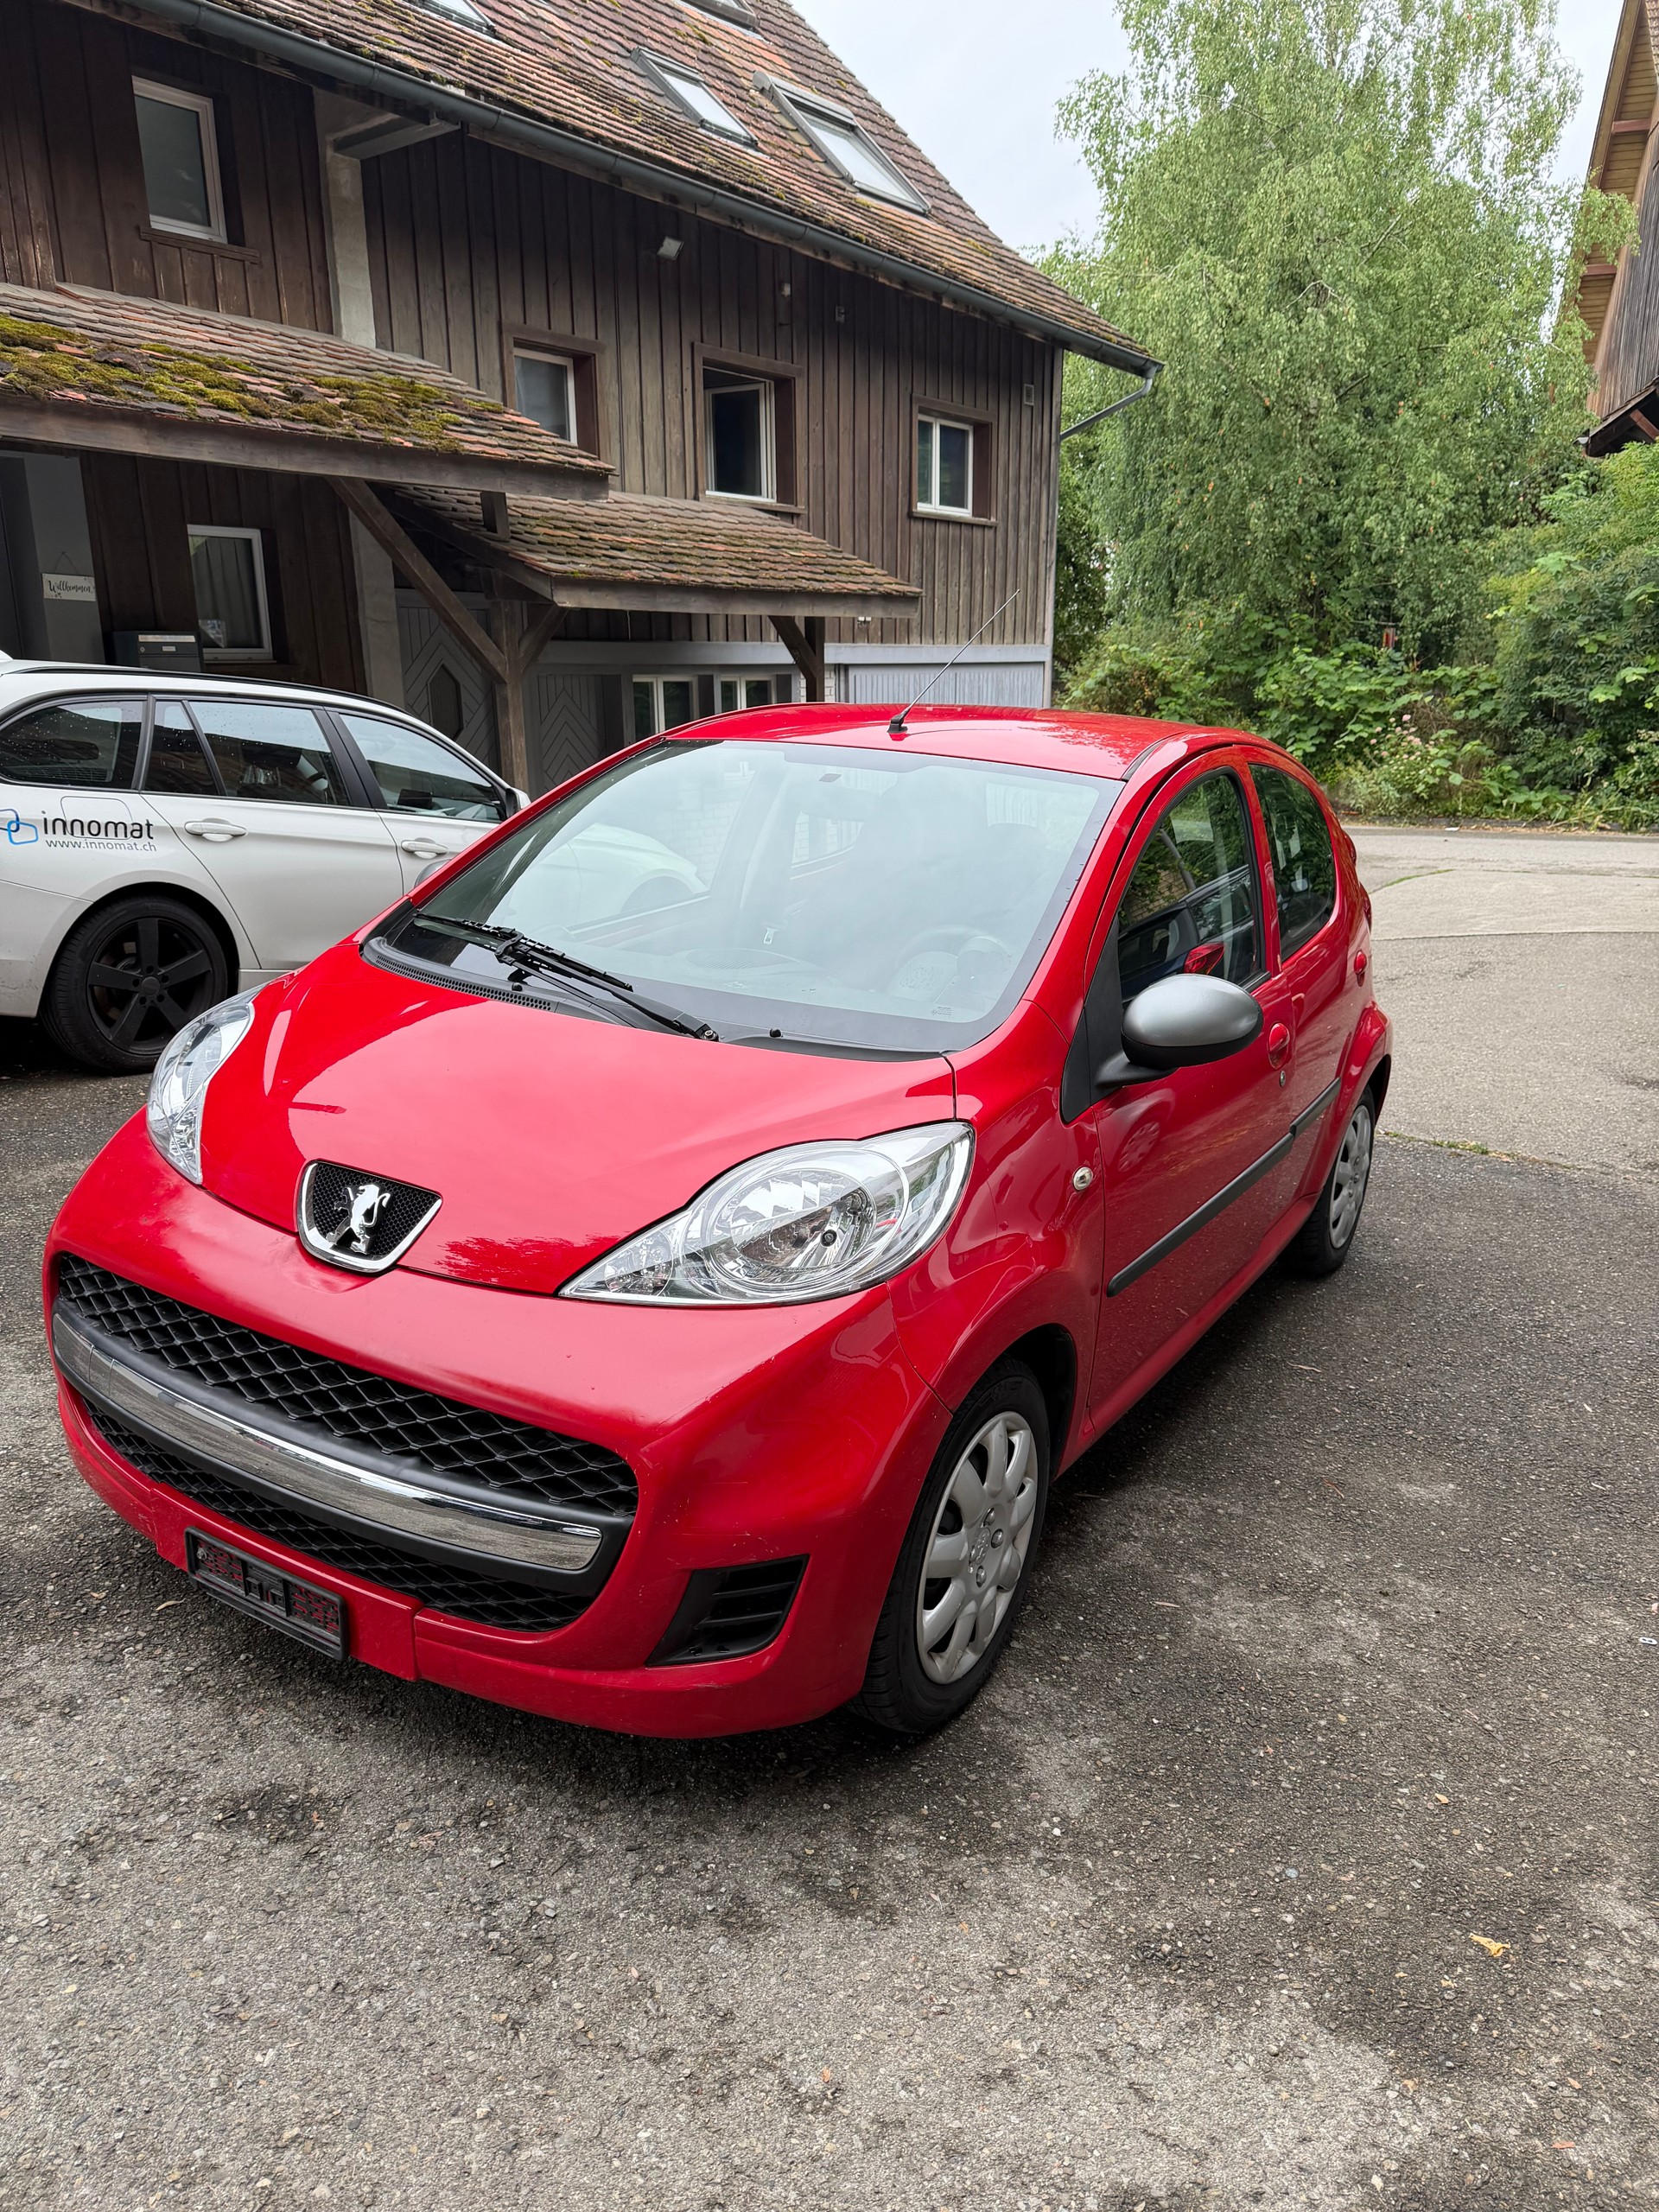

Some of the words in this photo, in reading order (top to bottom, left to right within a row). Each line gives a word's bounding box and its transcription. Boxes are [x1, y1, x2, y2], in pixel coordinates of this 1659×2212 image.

[48, 580, 91, 593] Willkommen
[41, 810, 154, 839] innomat
[45, 839, 157, 852] www.innomat.ch
